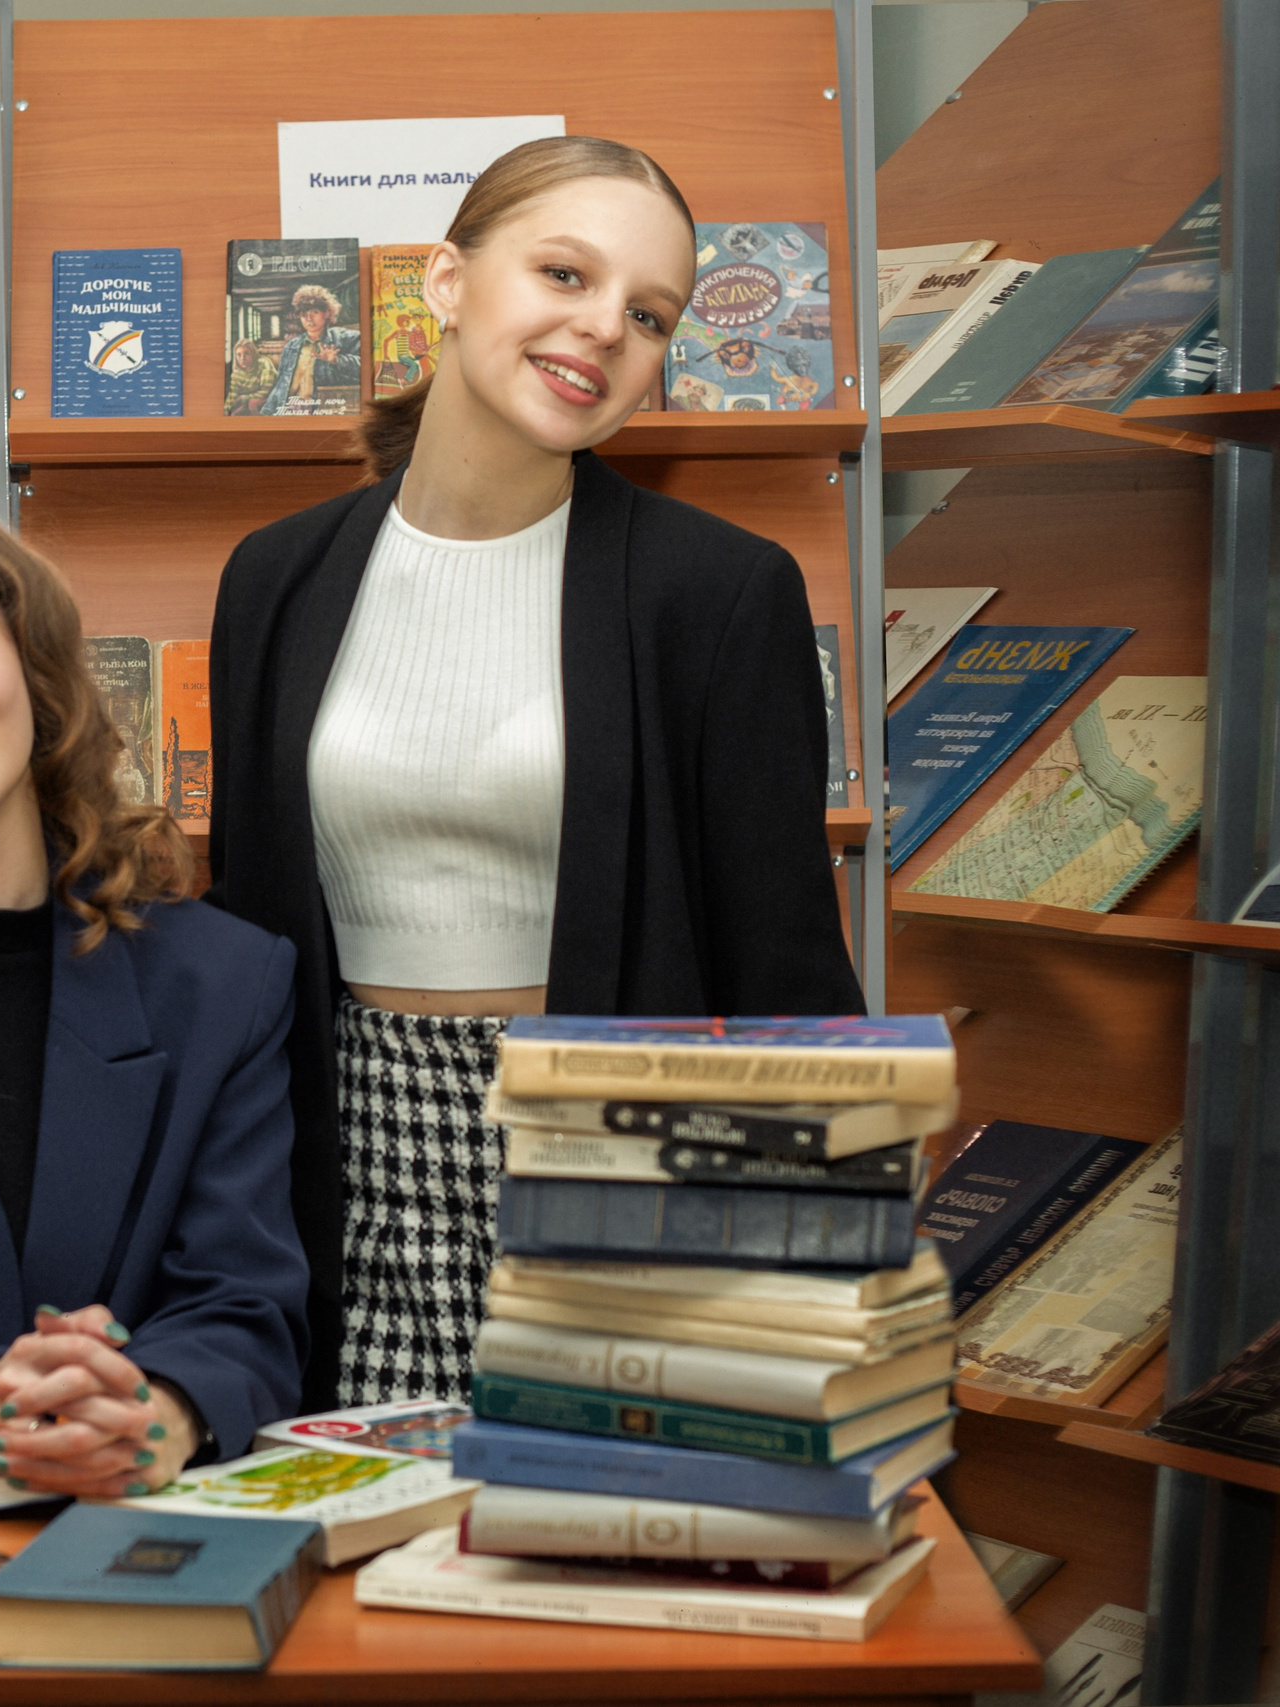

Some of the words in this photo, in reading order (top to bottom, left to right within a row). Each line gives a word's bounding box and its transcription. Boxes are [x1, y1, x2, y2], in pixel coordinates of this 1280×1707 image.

[309, 172, 372, 188] Книги
[378, 173, 417, 189] для
[423, 170, 481, 186] малы
[298, 252, 347, 272] СТАЙН
[80, 278, 153, 295] ДОРОГИЕ
[691, 266, 777, 308] ПРИКЛЮЧЕНИЯ
[704, 281, 770, 307] КАПИТАНА
[102, 290, 132, 301] МОИ
[70, 300, 162, 315] МАЛЬЧИШКИ
[285, 396, 321, 406] Тихая
[324, 397, 346, 406] ночь
[273, 406, 309, 416] Тихая
[99, 660, 148, 670] РЫБАКОВ
